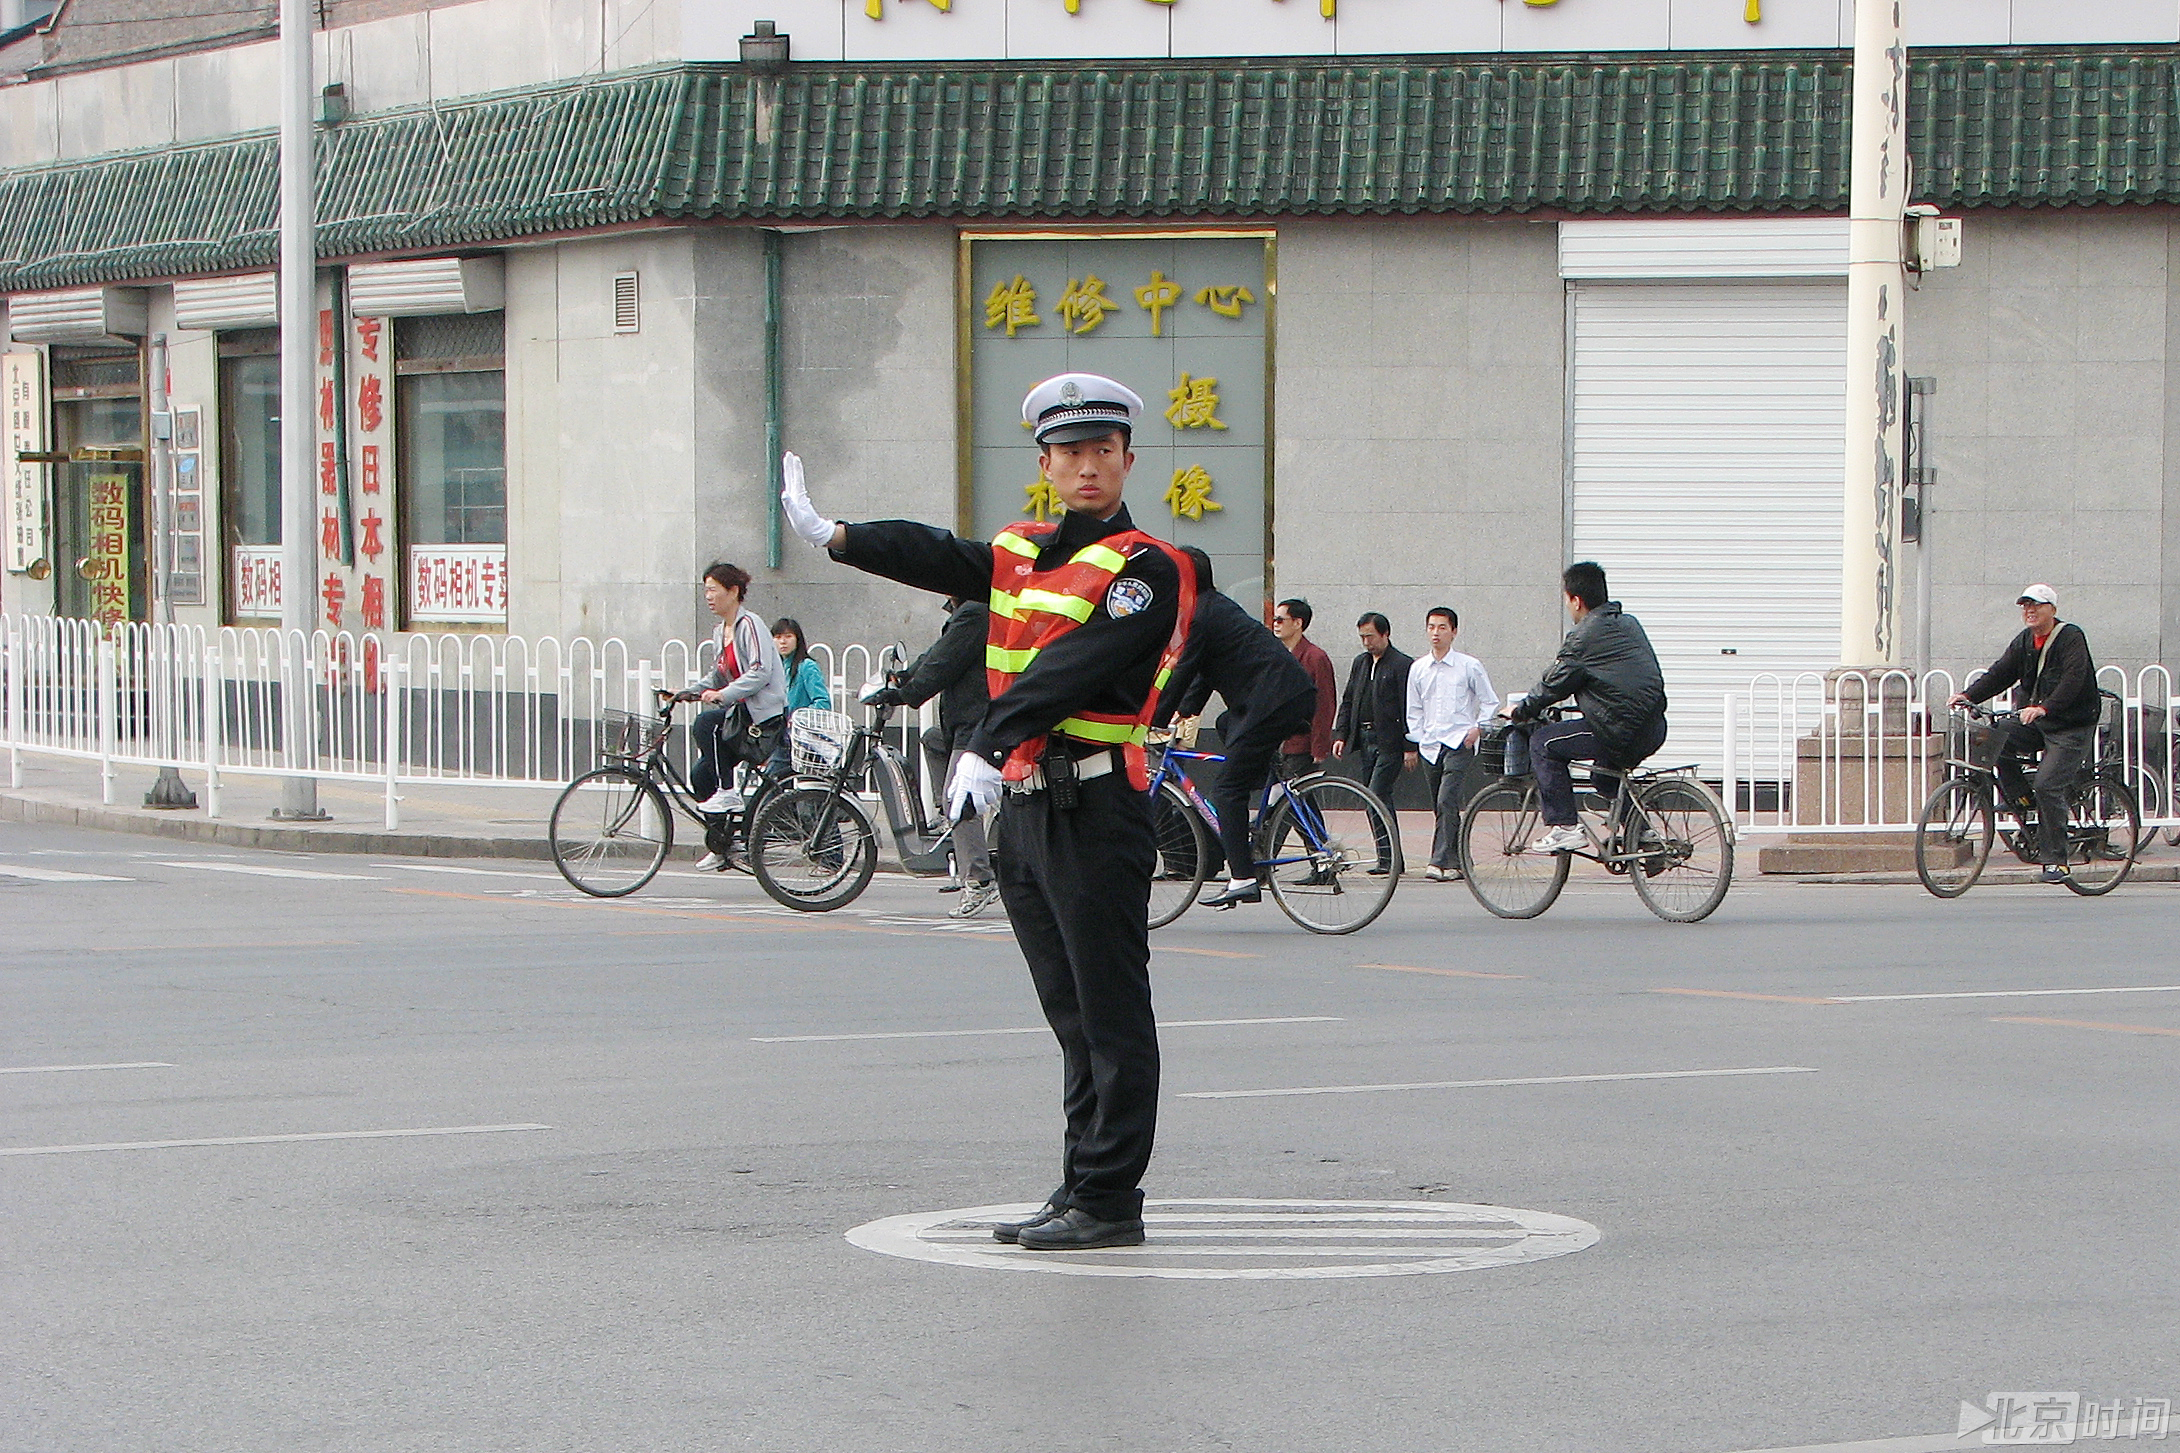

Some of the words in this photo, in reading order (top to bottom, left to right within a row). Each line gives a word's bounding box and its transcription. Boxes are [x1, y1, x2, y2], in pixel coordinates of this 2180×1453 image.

[984, 270, 1256, 338] 维修中心
[1164, 372, 1229, 521] 摄像
[91, 480, 126, 680] 数码相机快修
